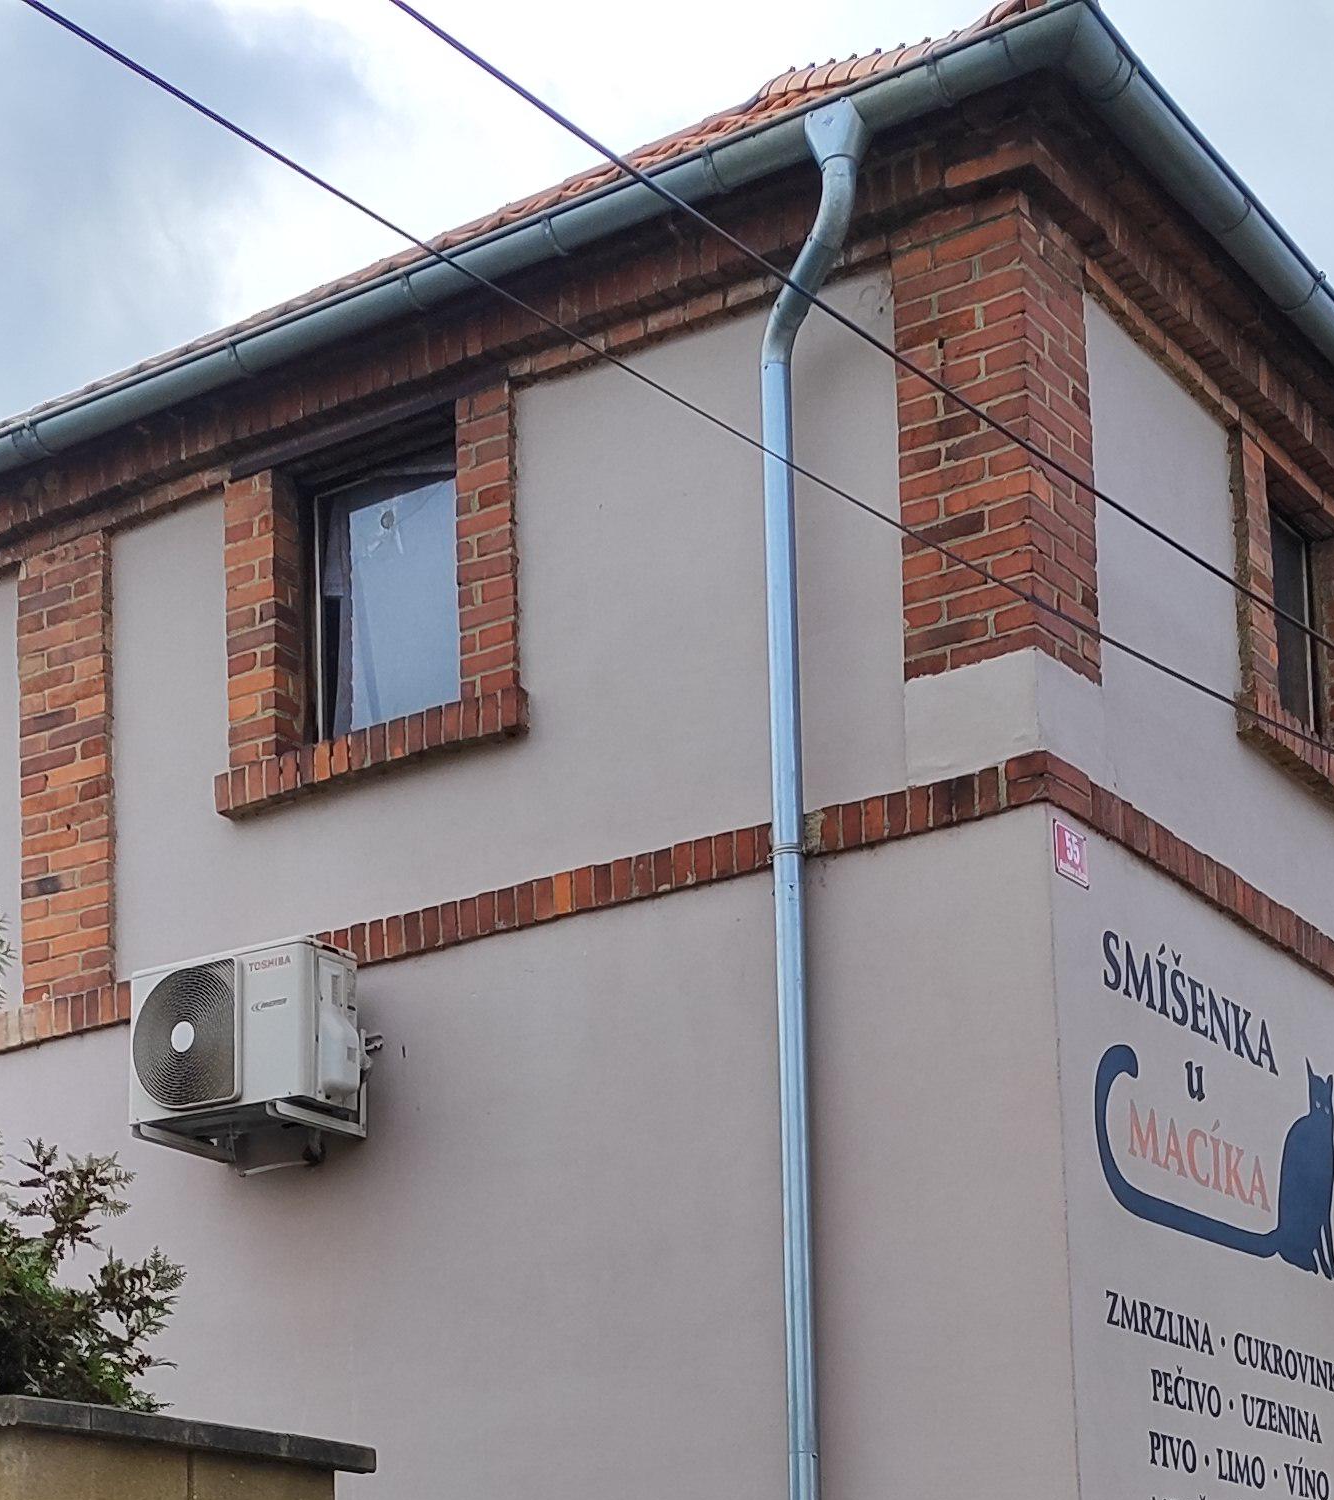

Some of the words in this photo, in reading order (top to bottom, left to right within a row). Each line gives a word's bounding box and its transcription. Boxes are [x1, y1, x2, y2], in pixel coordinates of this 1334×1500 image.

[248, 955, 291, 972] TOSHIBA
[1101, 929, 1279, 1077] SMÍŠENKA
[1127, 1099, 1272, 1213] MACÍKA
[1105, 1290, 1215, 1356] ZMRZLINA
[1150, 1365, 1222, 1418] PEČIVO
[1241, 1392, 1323, 1444] UZENINA
[1149, 1430, 1197, 1474] PIVO
[1216, 1447, 1266, 1489] LIMO
